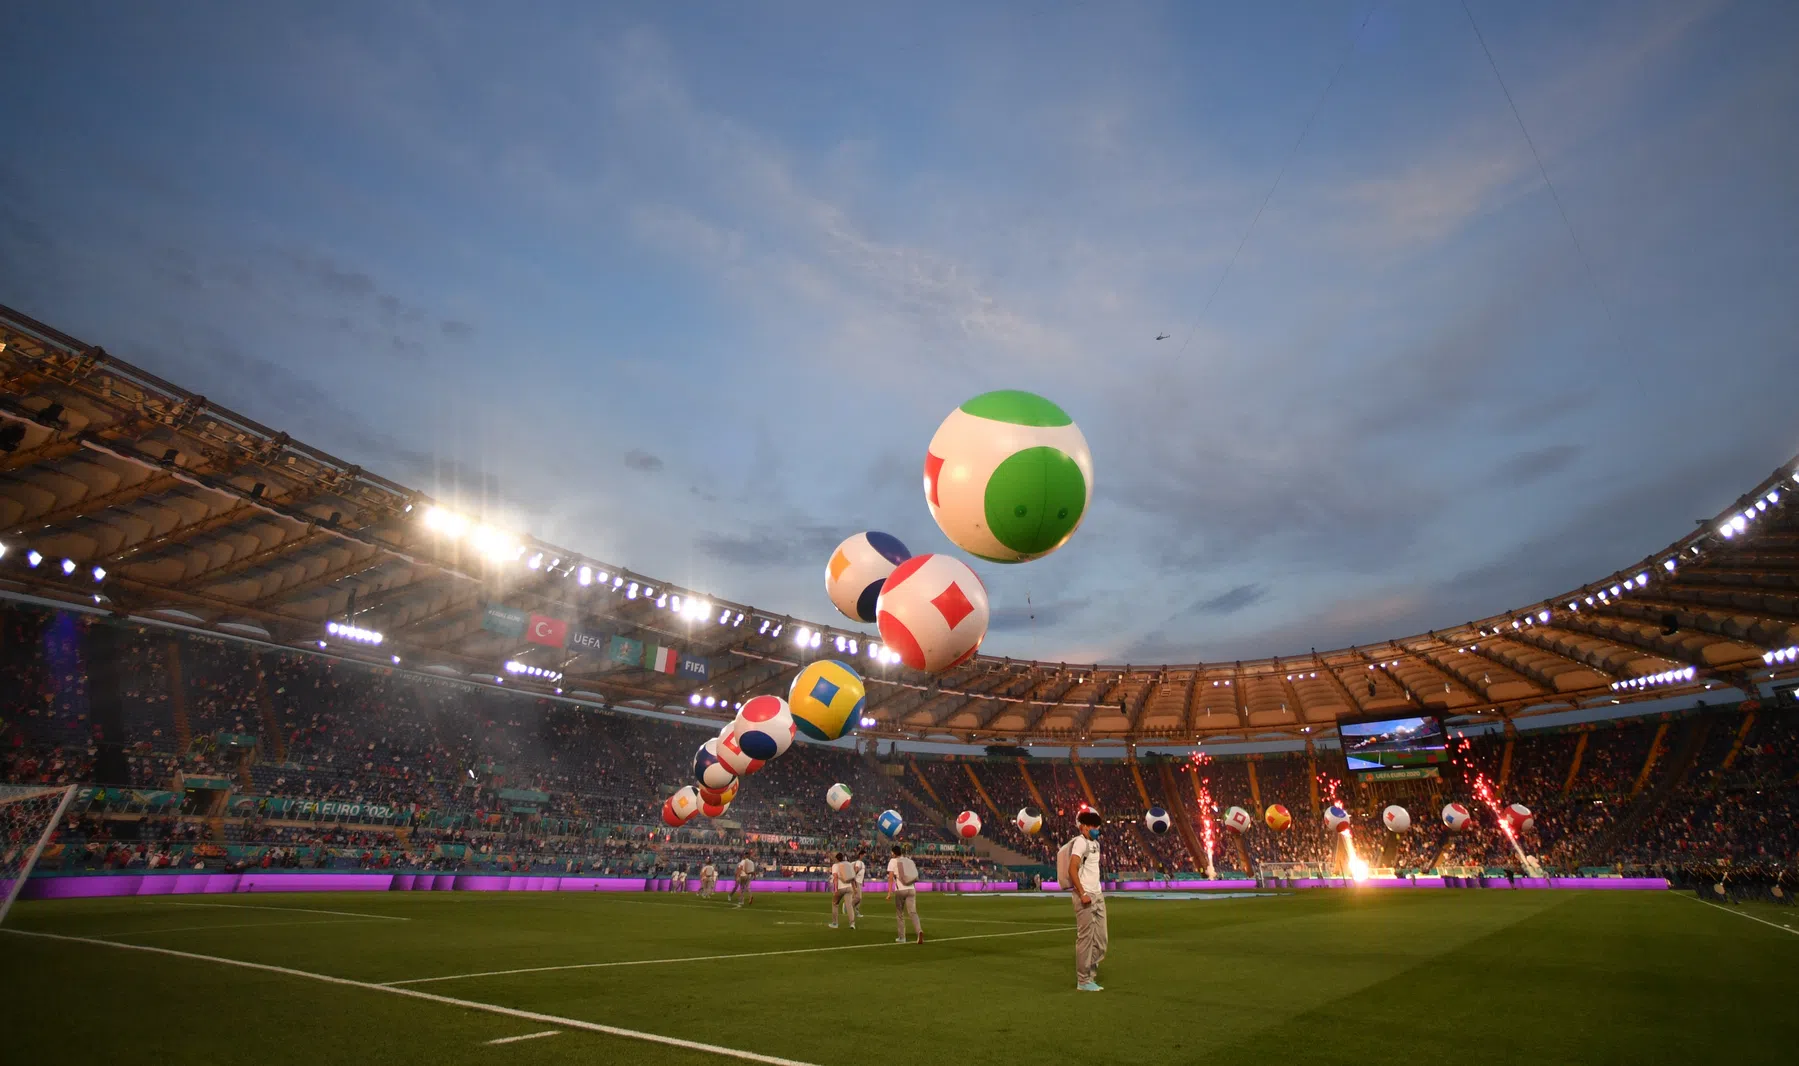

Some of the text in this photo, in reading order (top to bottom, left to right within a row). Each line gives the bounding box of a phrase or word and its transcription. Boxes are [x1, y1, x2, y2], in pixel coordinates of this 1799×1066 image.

[573, 633, 601, 649] UEFA
[684, 660, 705, 674] FIFA
[323, 802, 360, 817] EURO
